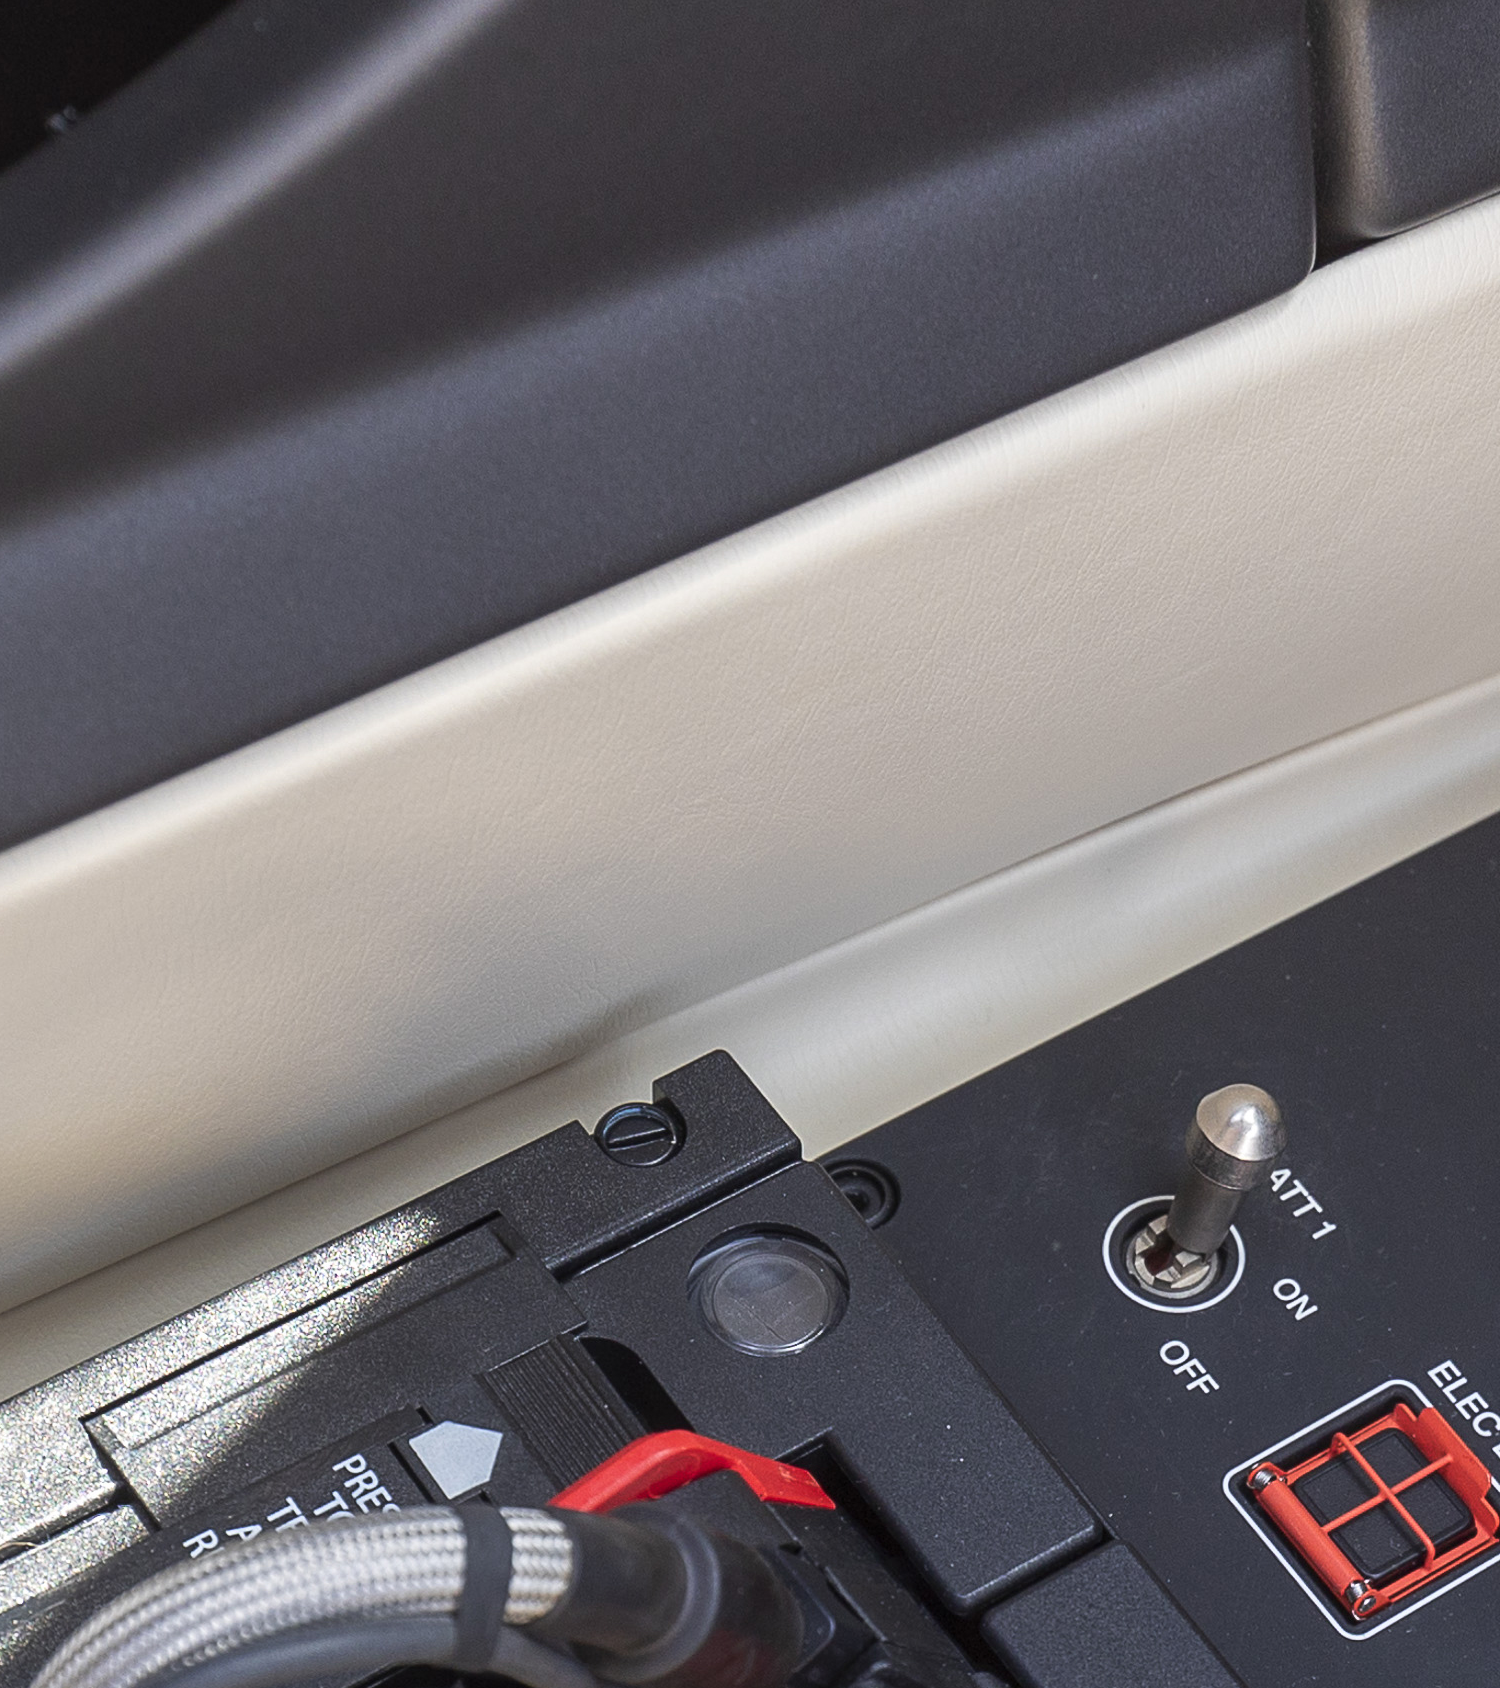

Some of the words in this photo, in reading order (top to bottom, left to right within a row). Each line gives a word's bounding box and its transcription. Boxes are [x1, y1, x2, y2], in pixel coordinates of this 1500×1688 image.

[1270, 1168, 1324, 1218] ATT
[1311, 1221, 1337, 1240] 1
[1273, 1279, 1318, 1320] ON
[1160, 1341, 1219, 1393] OFF
